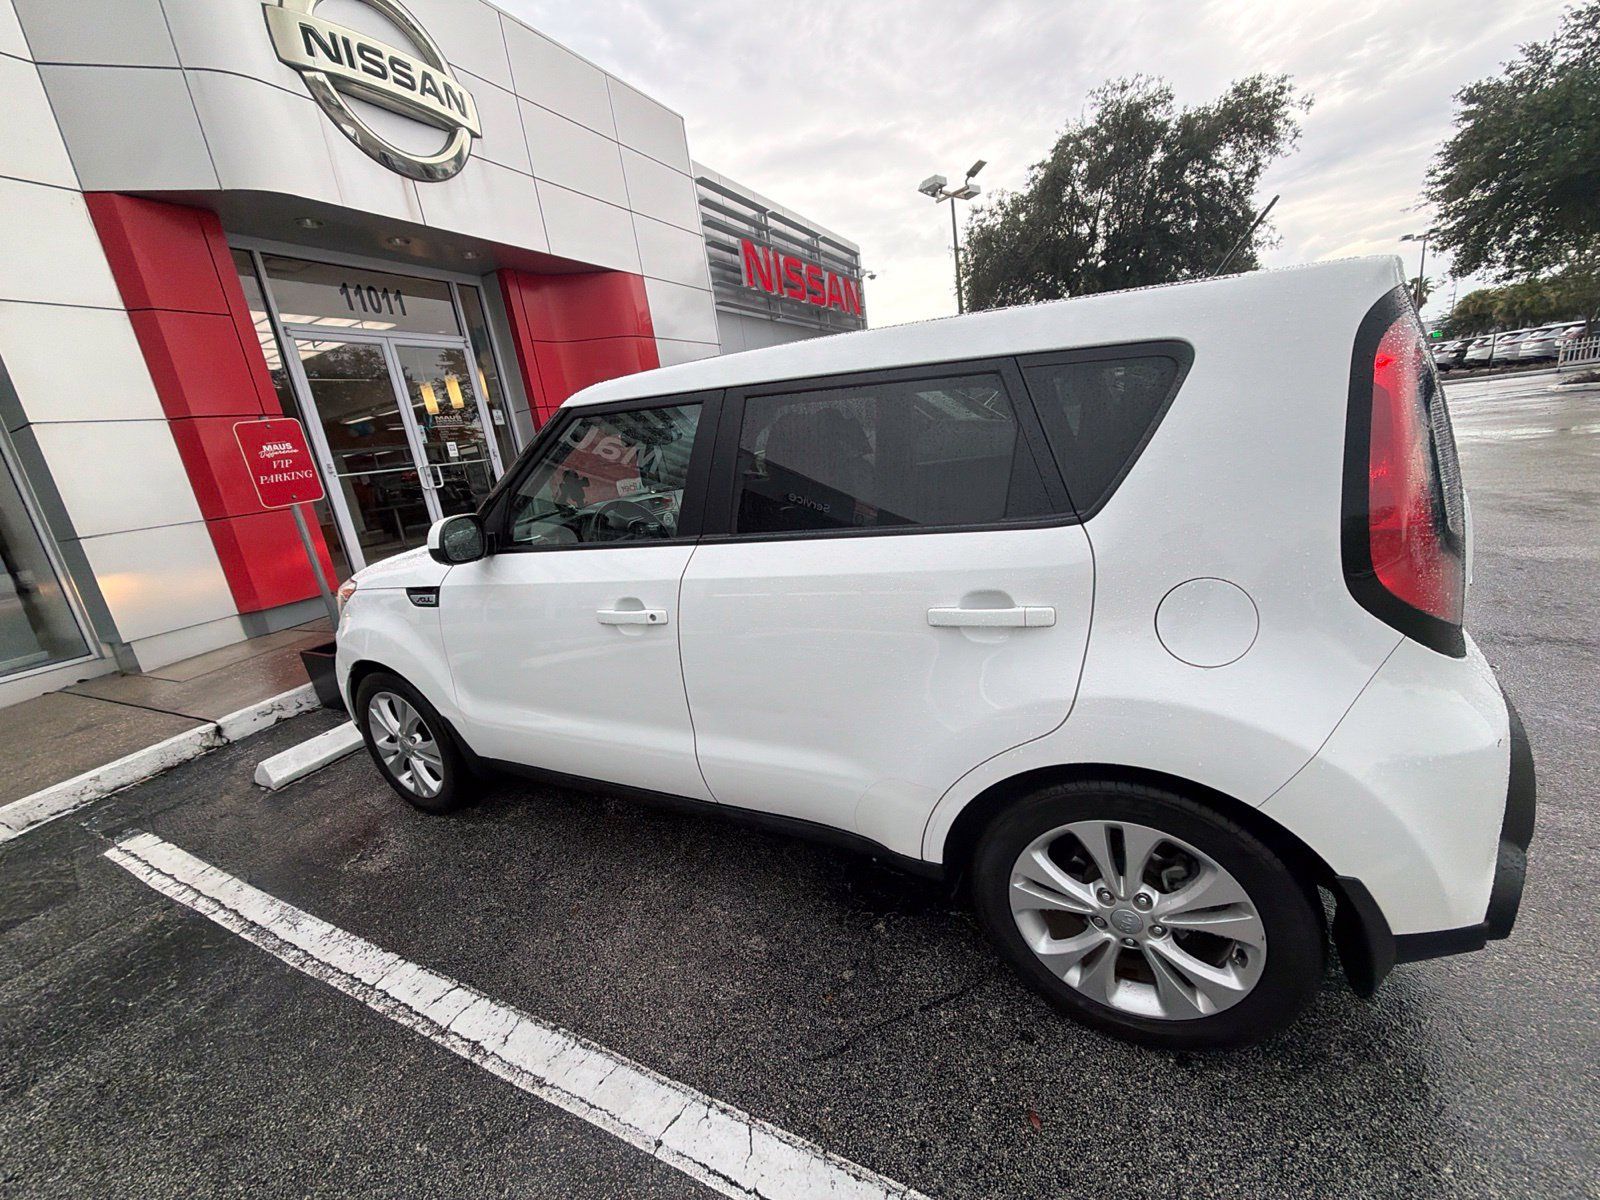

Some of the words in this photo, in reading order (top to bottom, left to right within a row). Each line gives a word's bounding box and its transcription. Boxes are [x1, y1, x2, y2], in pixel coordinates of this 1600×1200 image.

[298, 21, 469, 119] NISSAN
[740, 237, 862, 317] NISSAN
[339, 282, 406, 316] 11011
[262, 442, 293, 451] MAUS
[272, 459, 293, 469] VIP
[260, 470, 313, 484] PARKING
